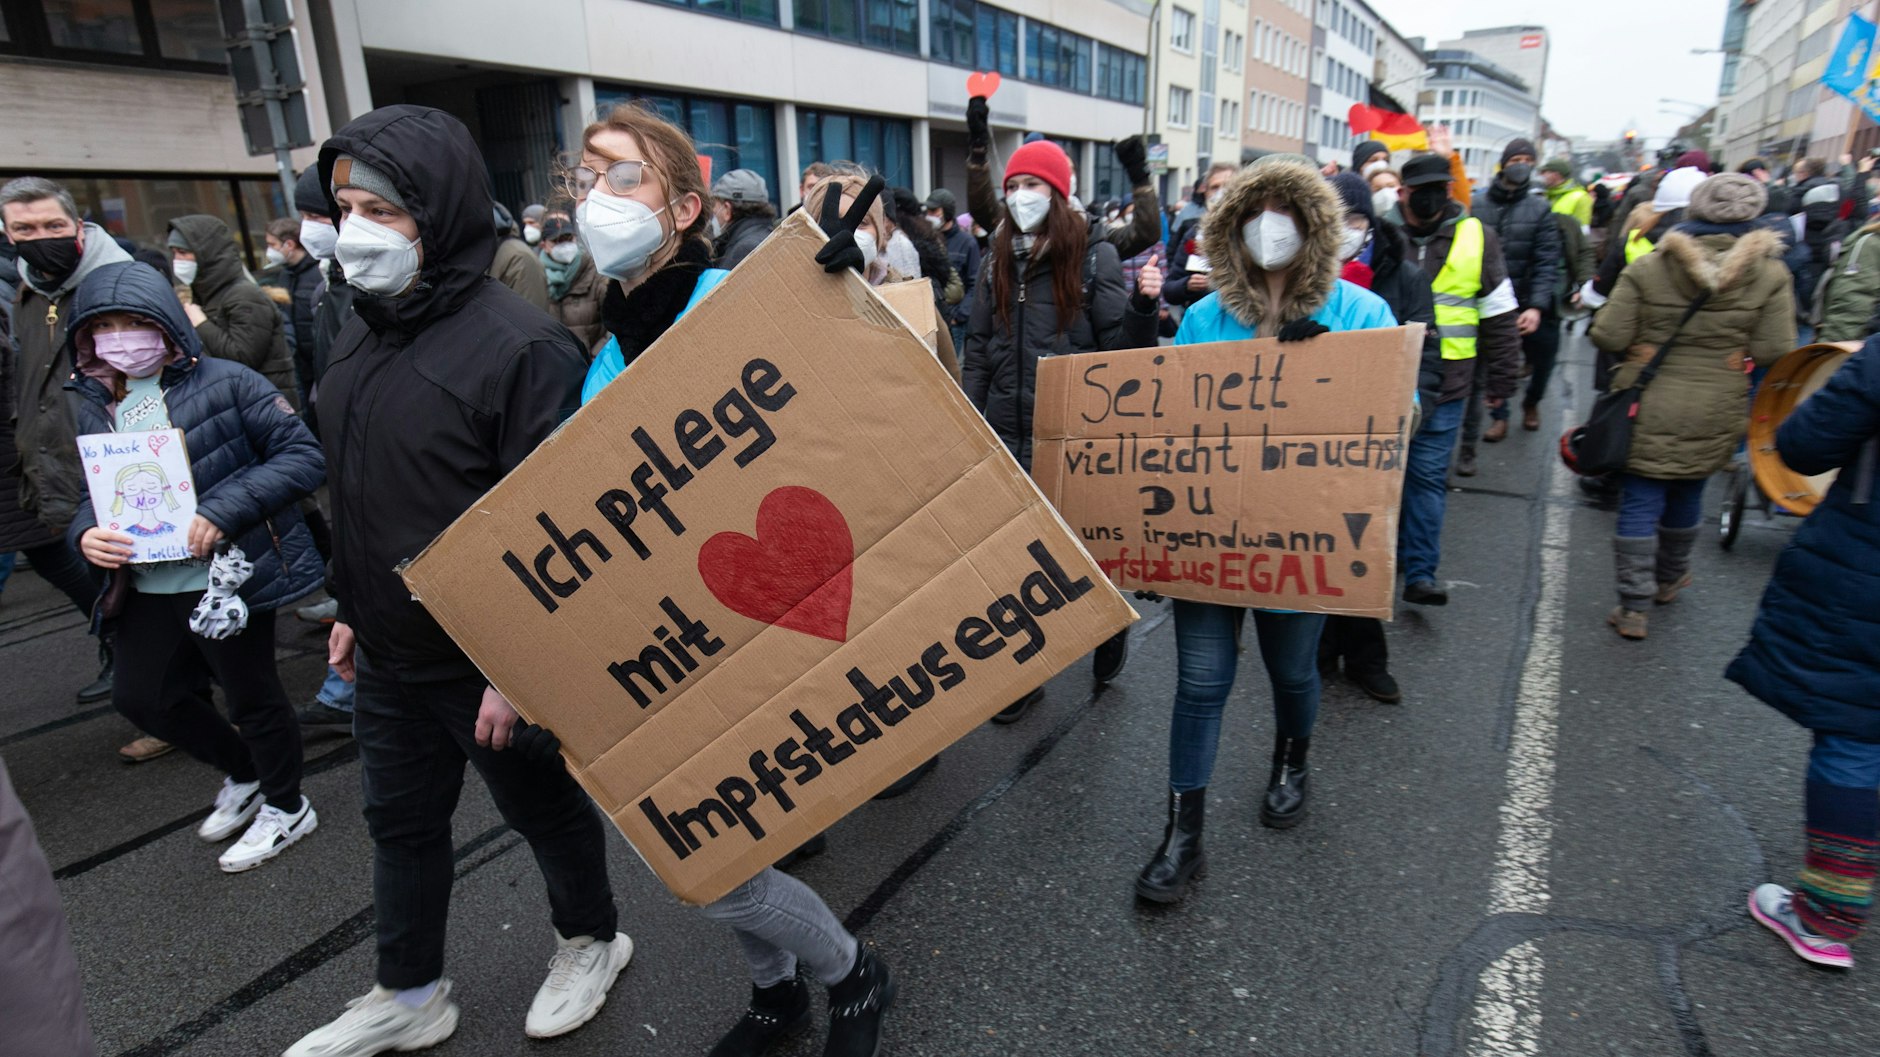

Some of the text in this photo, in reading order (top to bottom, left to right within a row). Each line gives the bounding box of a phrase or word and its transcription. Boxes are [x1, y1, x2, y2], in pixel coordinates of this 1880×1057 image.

[1081, 355, 1165, 424] Sei
[1194, 354, 1288, 412] nett
[83, 440, 140, 458] No Mask
[1065, 415, 1405, 476] vielleicht brauchst
[502, 511, 613, 614] Ich
[1082, 526, 1125, 541] uns
[607, 596, 726, 710] mit
